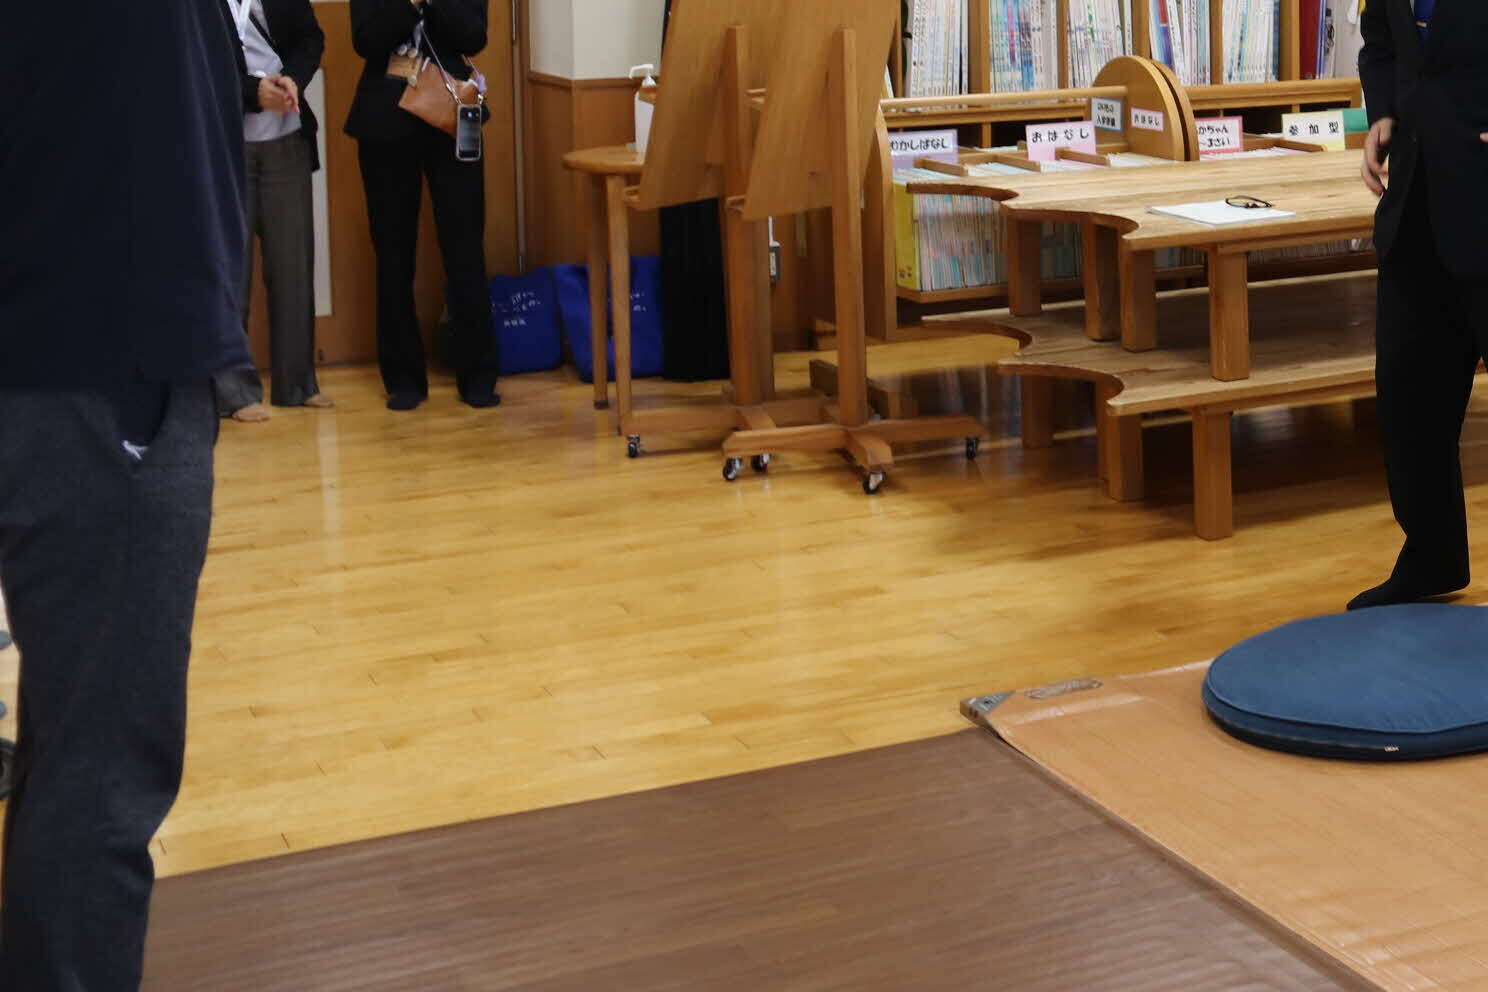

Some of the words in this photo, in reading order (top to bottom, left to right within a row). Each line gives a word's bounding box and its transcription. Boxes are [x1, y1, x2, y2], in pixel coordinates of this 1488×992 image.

[1031, 128, 1089, 144] おはなし
[1288, 120, 1339, 136] 参加型
[890, 136, 948, 152] むかしばなし
